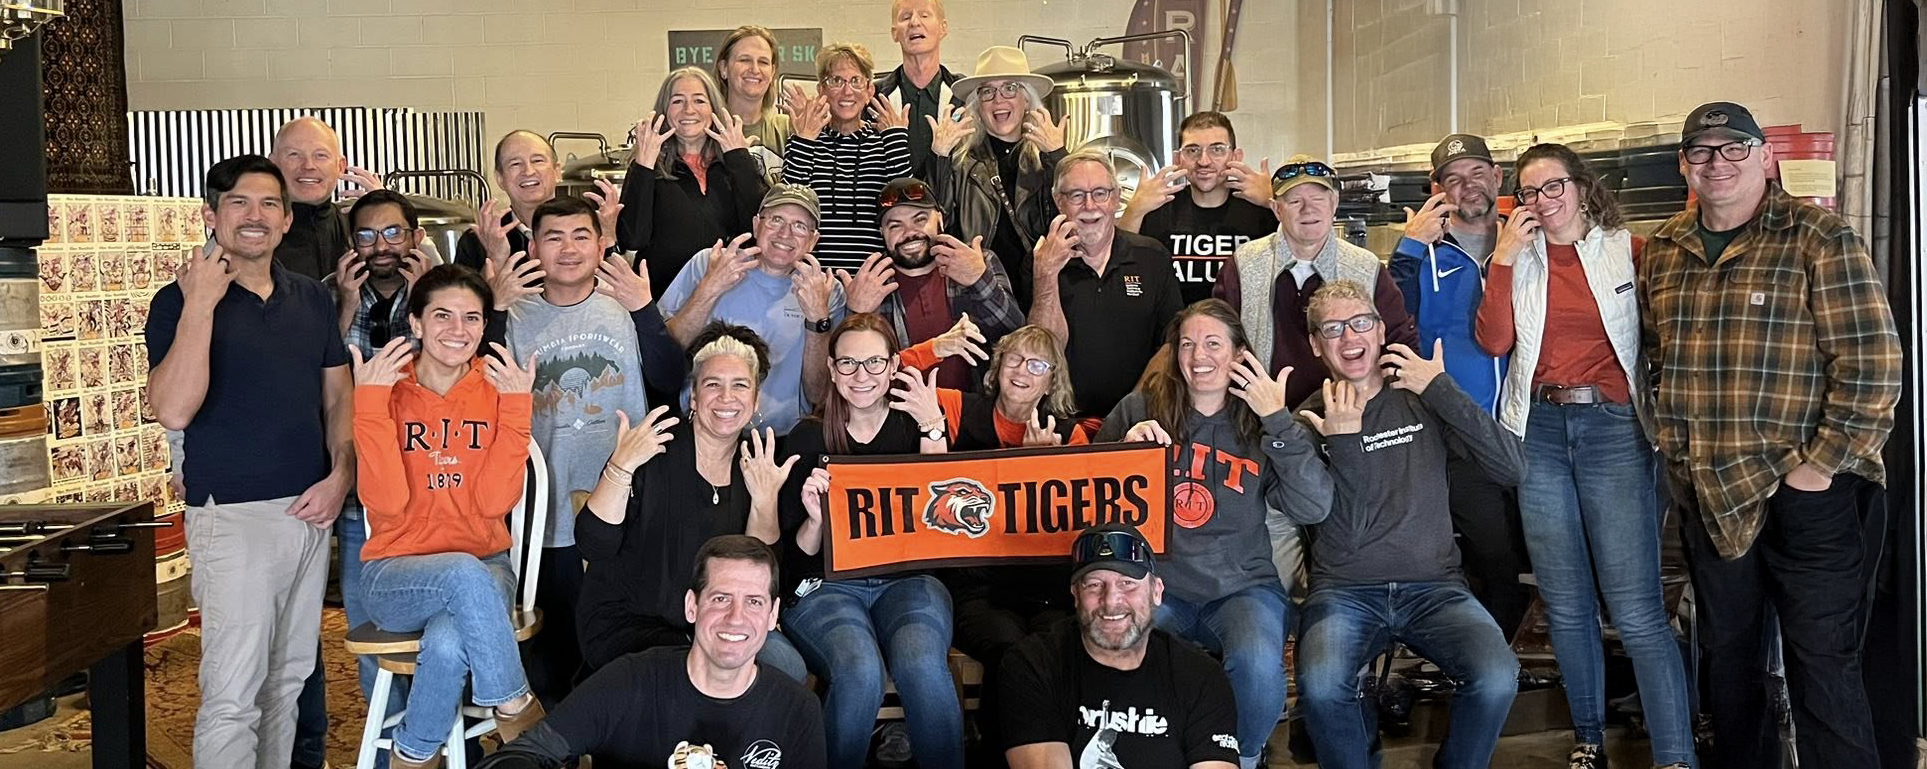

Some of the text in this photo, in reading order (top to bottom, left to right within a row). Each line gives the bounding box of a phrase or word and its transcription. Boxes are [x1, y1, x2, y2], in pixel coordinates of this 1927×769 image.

[676, 47, 713, 64] BYE
[845, 474, 1150, 540] RIT TIGERS
